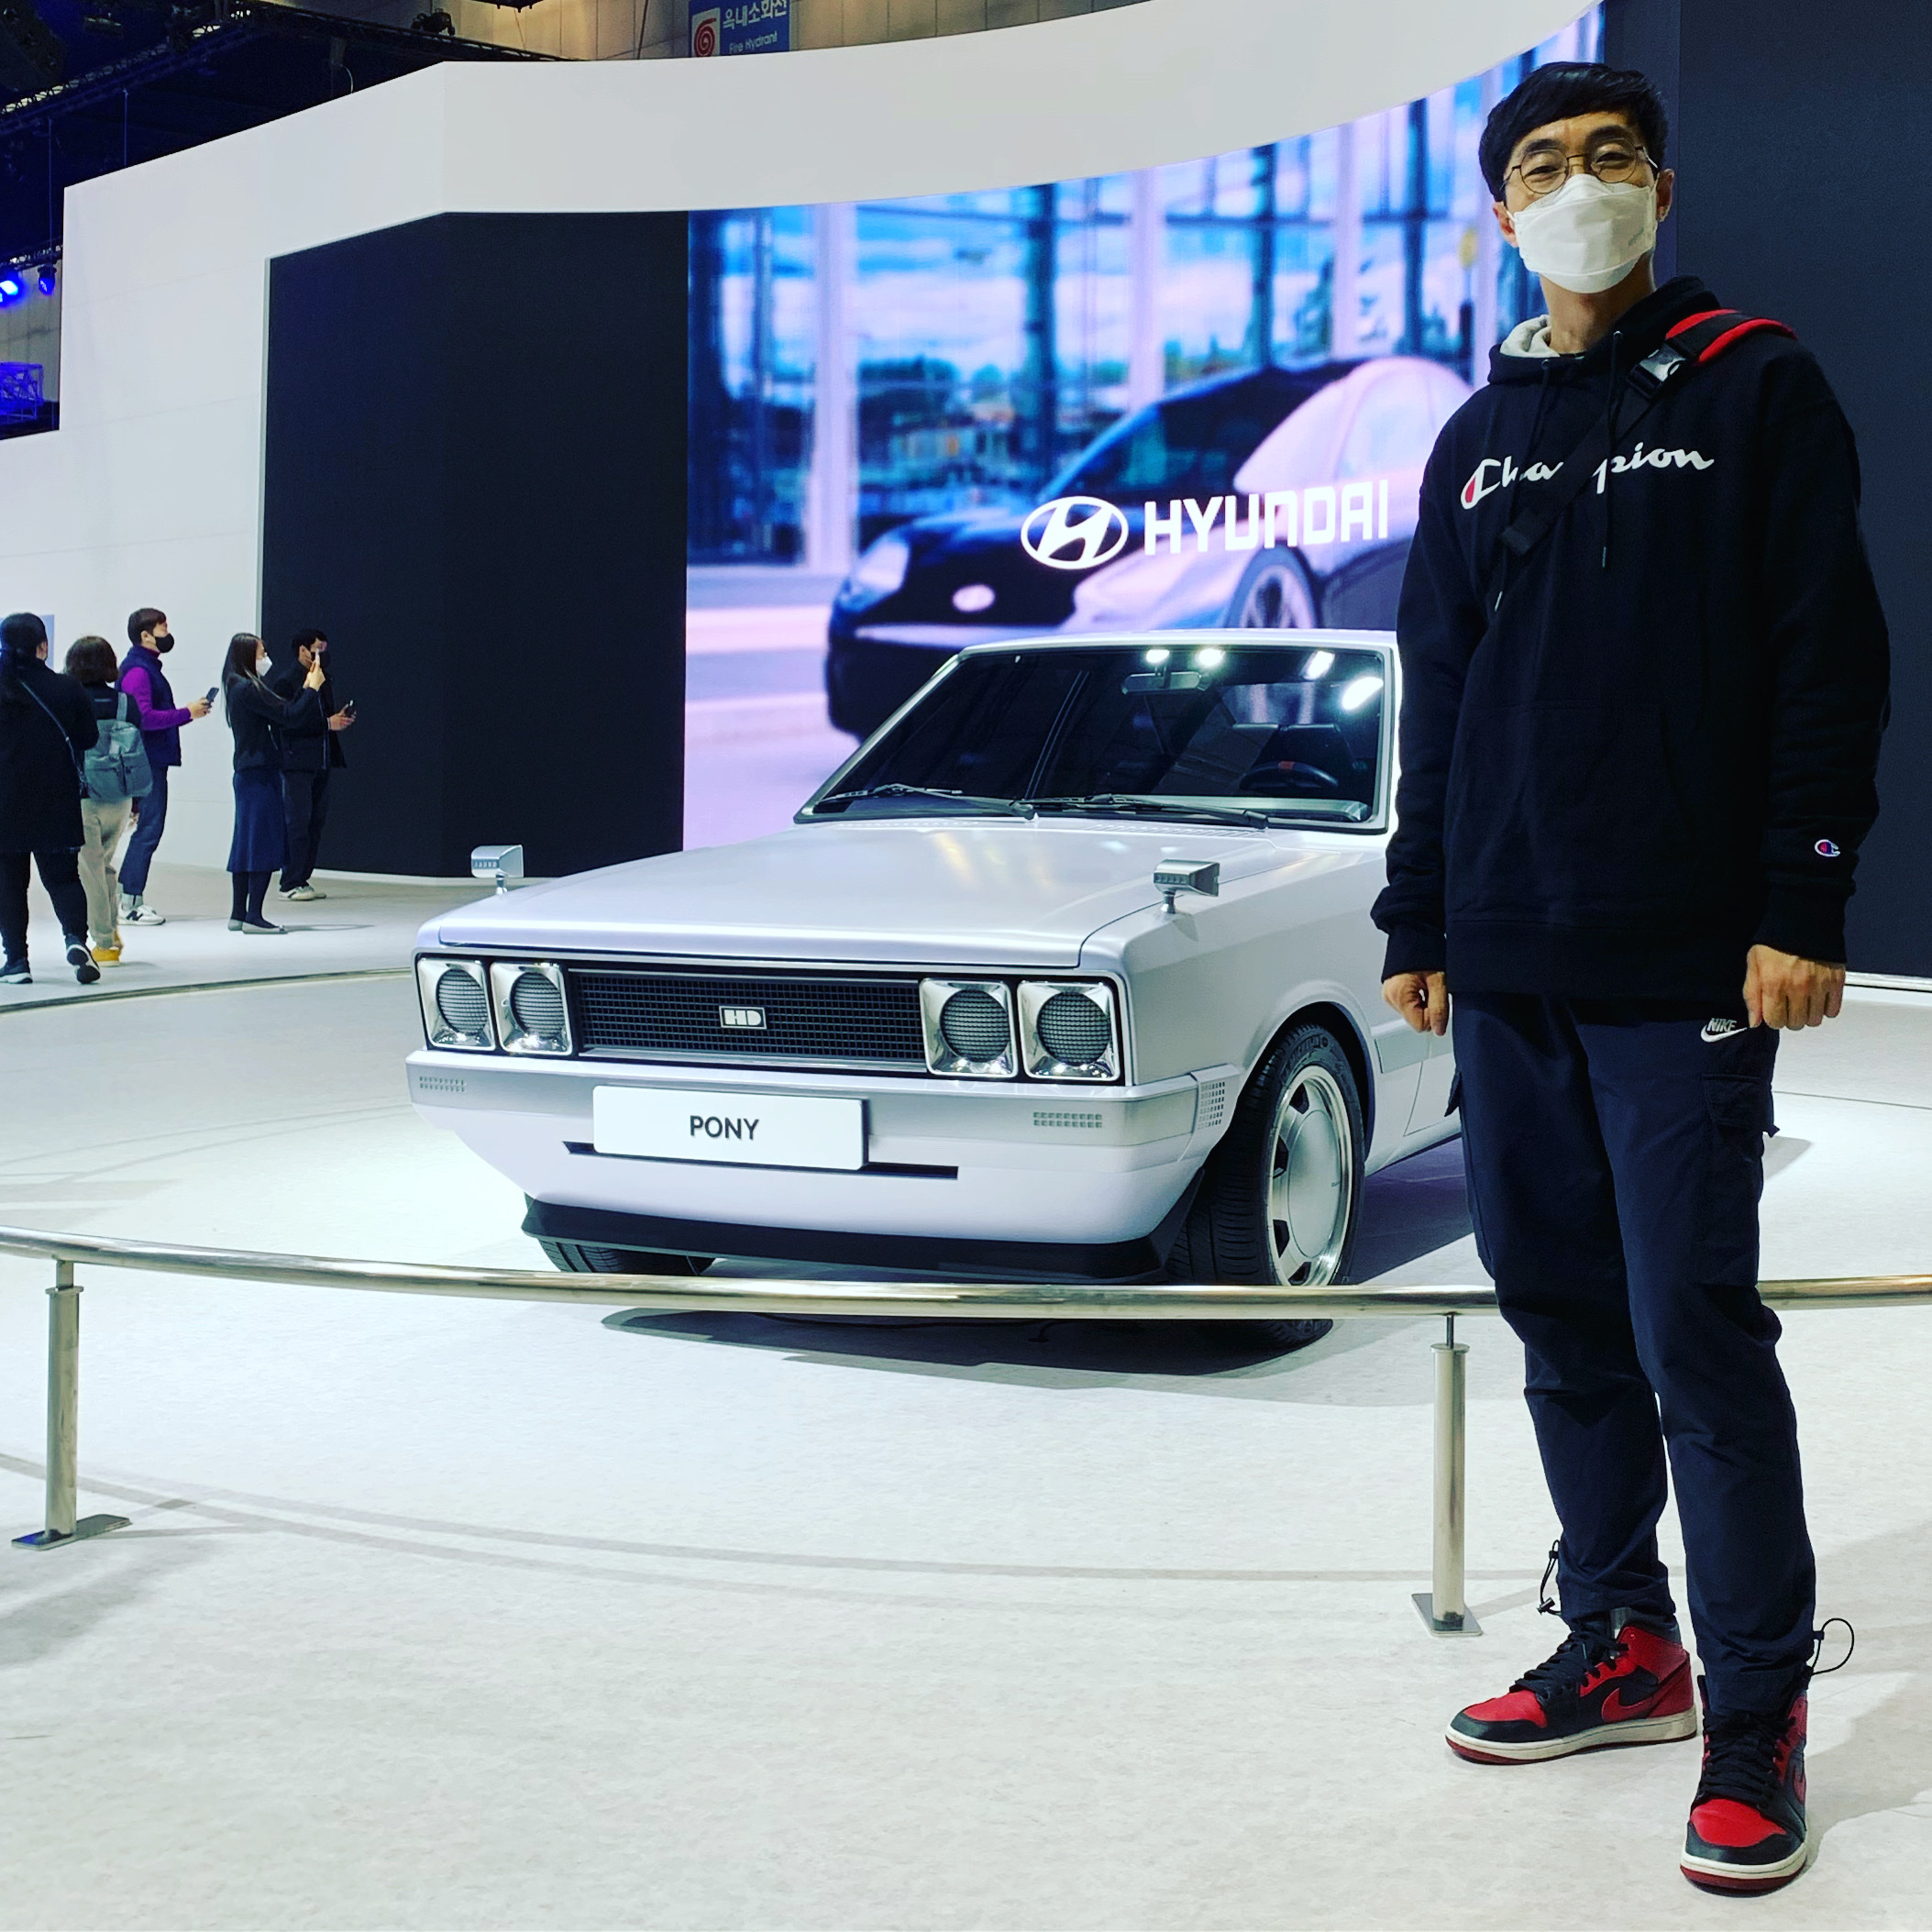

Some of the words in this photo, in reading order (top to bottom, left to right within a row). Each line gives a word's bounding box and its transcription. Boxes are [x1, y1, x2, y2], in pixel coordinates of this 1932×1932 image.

[723, 0, 788, 30] 옥내소화전
[729, 42, 744, 54] Fire
[745, 30, 778, 52] Hydrant
[1460, 442, 1715, 510] Chapion
[1143, 479, 1389, 556] HYUNDAI
[723, 1009, 762, 1026] HD
[1706, 1017, 1738, 1032] NIKE
[689, 1114, 760, 1141] PONY
